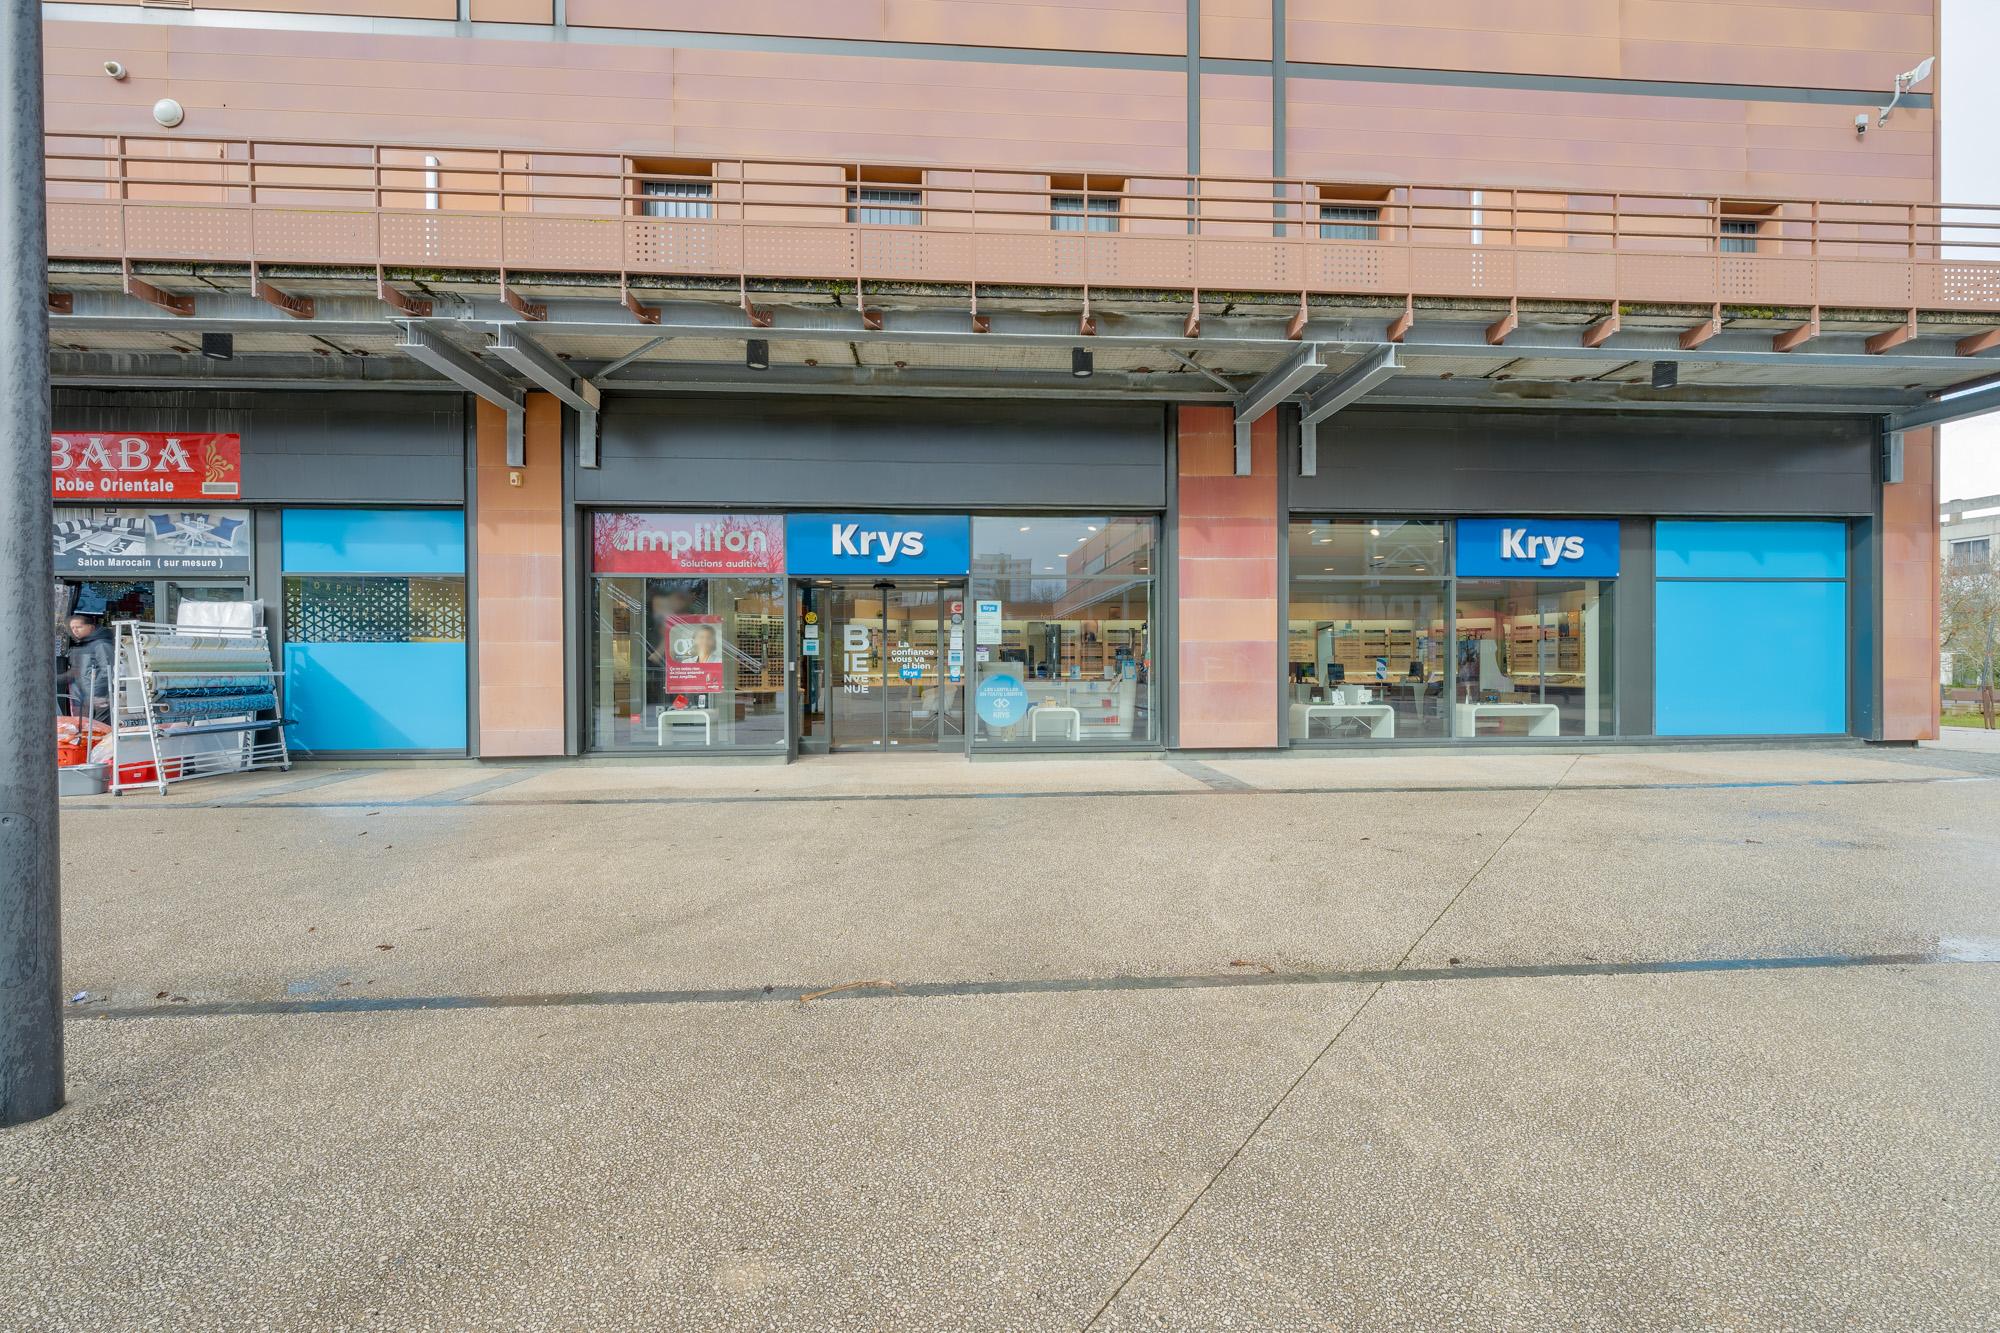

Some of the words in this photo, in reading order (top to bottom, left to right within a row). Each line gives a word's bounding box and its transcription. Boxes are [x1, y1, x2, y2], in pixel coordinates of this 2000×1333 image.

[51, 437, 195, 472] BABA
[55, 477, 95, 492] Robe
[100, 477, 174, 493] Orientale
[612, 522, 768, 560] amplifon
[832, 524, 924, 563] Krys
[1502, 528, 1585, 566] Krys
[77, 557, 105, 567] Salon
[108, 558, 151, 567] Marocain
[680, 559, 723, 568] Solutions
[725, 559, 768, 568] auditives
[891, 648, 935, 656] confiance
[902, 662, 910, 670] si
[911, 662, 931, 670] bien
